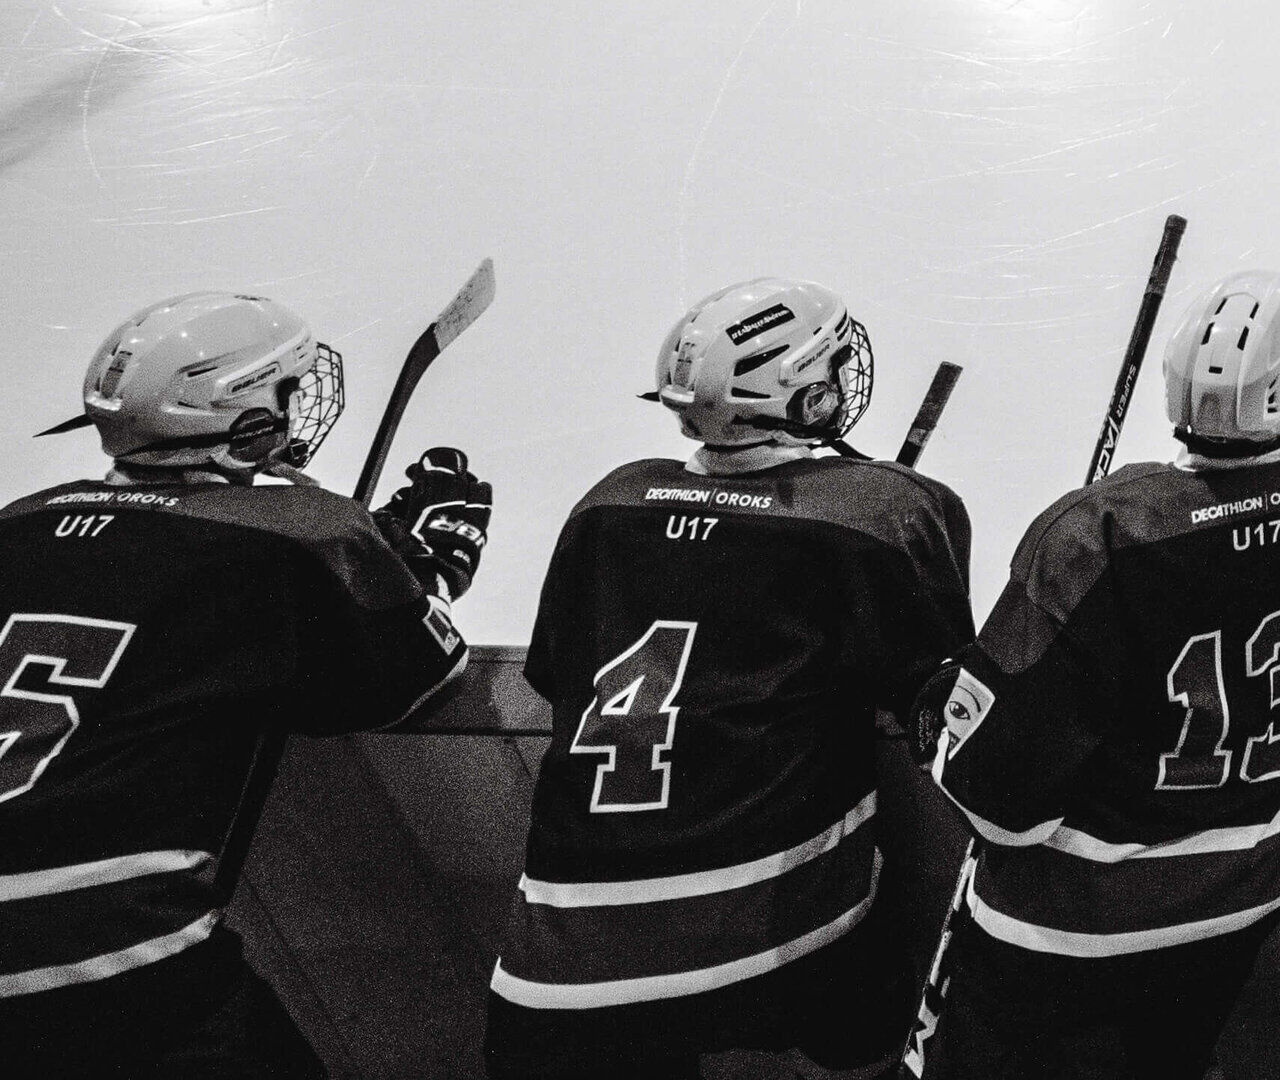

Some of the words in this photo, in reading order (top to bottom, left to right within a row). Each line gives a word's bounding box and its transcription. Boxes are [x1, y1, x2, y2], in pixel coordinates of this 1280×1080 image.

[645, 488, 711, 503] DECATHLON
[715, 492, 773, 509] OROKS
[1191, 496, 1263, 524] DECATHLON
[55, 515, 115, 538] U17
[665, 515, 719, 541] U17
[570, 619, 698, 814] 4
